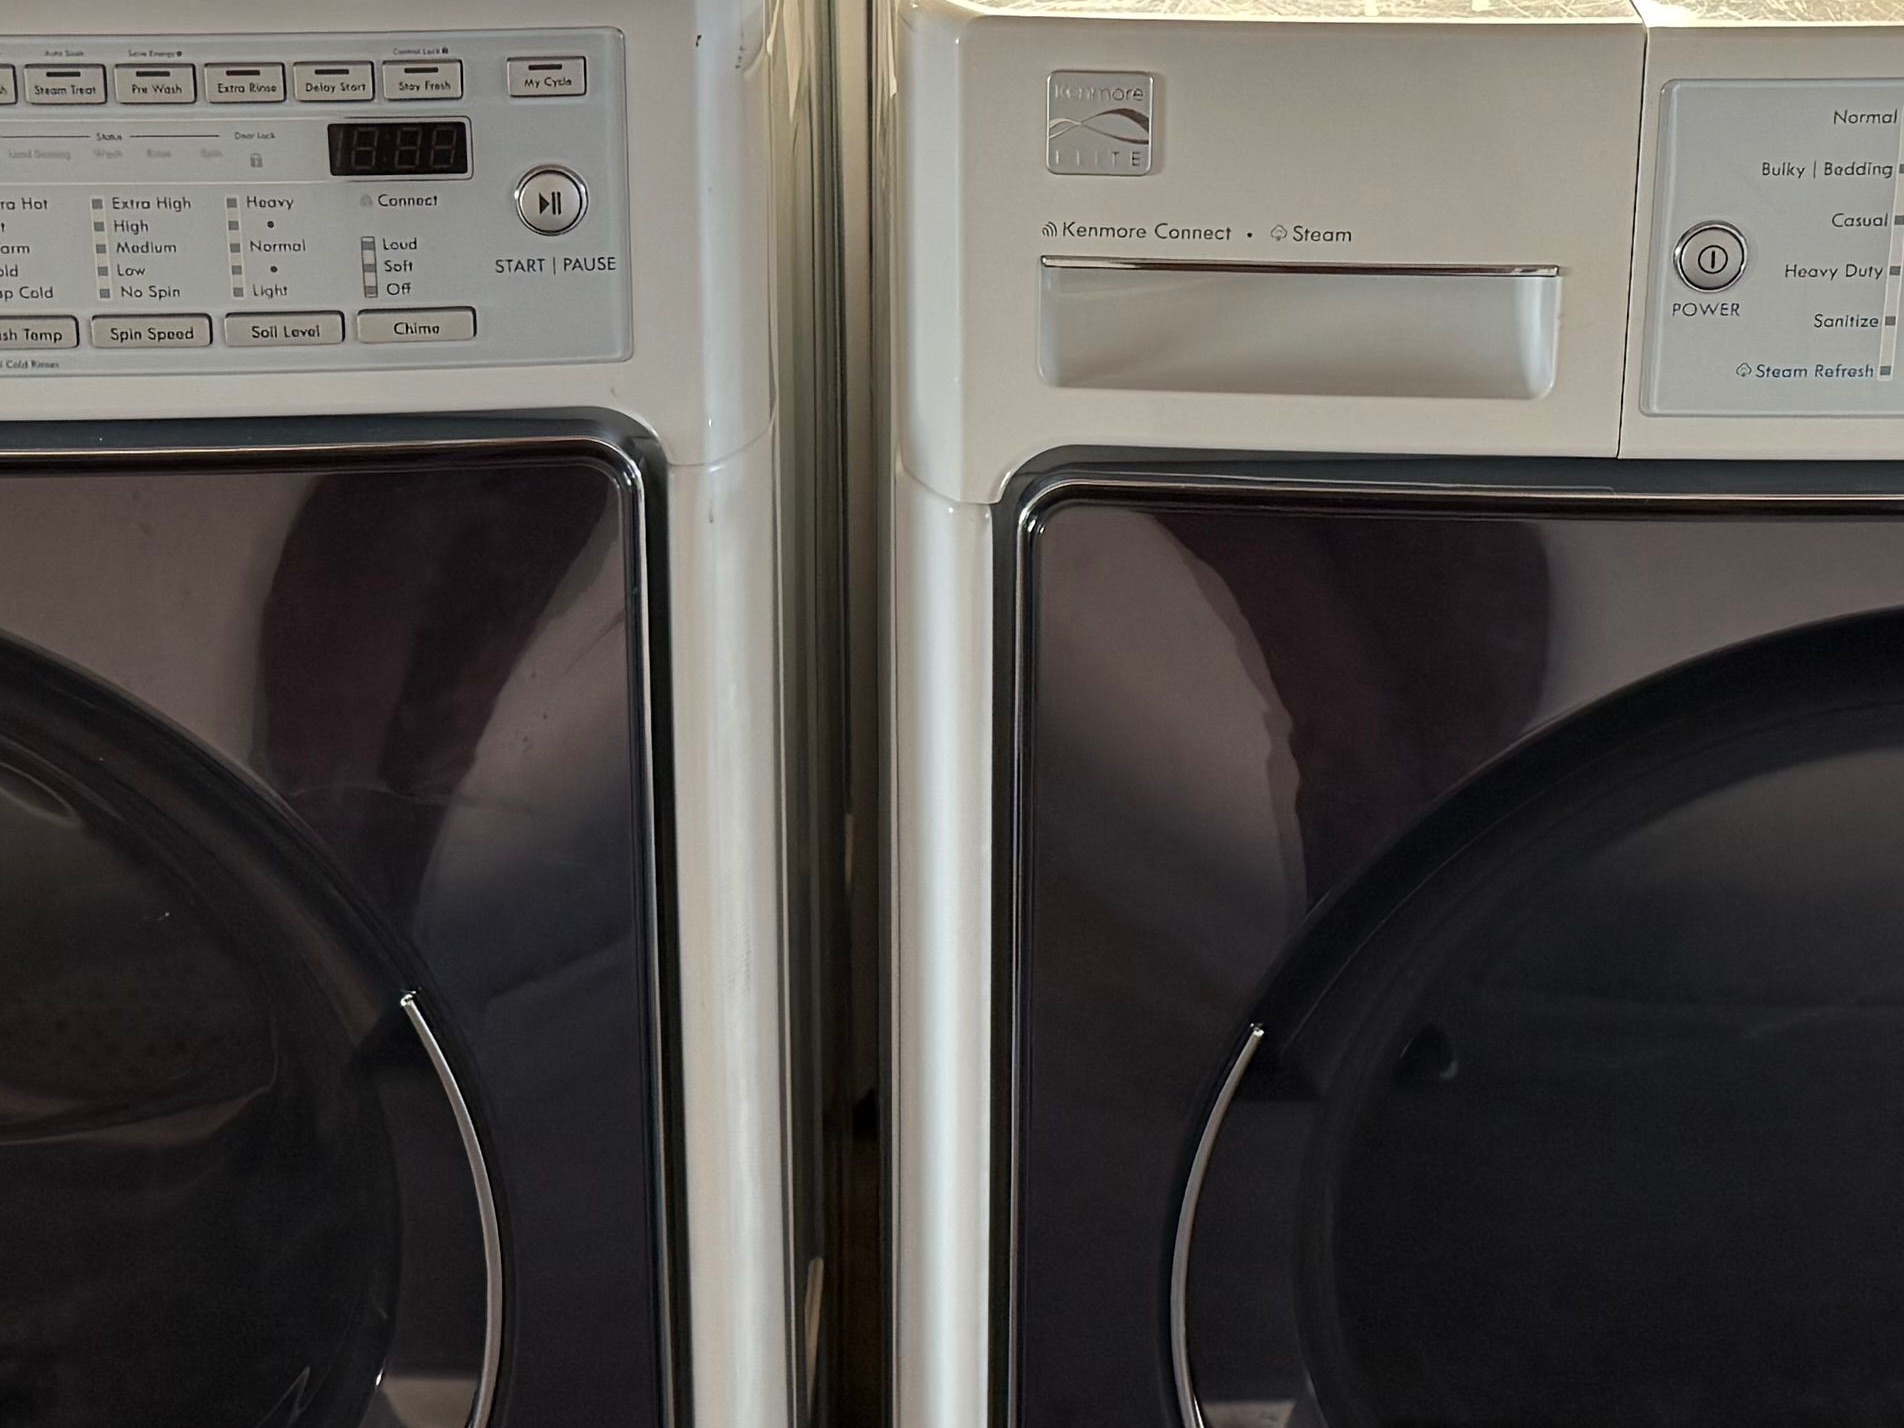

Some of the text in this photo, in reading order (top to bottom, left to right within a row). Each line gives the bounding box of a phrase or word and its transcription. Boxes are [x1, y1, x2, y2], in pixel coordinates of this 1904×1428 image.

[218, 83, 277, 93] Extra Rinse
[305, 82, 366, 94] Delay Start
[425, 81, 451, 91] Fresh
[525, 77, 572, 88] My Cycle
[34, 85, 96, 96] Steam Treat
[132, 85, 182, 94] Pre Wash
[1833, 109, 1897, 124] Normal
[1762, 162, 1893, 178] Bulky Bedding
[21, 198, 48, 210] Hot
[113, 197, 191, 212] Extra High
[247, 196, 294, 210] Heavy
[378, 194, 437, 207] Connect
[1832, 213, 1888, 227] Casual
[114, 220, 148, 235] High
[1062, 221, 1352, 244] Kenmore Connect Steam
[116, 242, 177, 254] Medium
[250, 239, 306, 252] Normal
[383, 238, 417, 250] Loud
[117, 264, 146, 276] Low
[384, 260, 413, 272] Soft
[496, 257, 616, 273] START PAUSE
[1785, 264, 1883, 281] Heavy Duty
[19, 287, 53, 299] Cold
[121, 286, 180, 300] No Spin
[253, 285, 288, 299] Light
[387, 283, 411, 295] Off
[1672, 303, 1740, 317] POWER
[1814, 314, 1879, 328] Sanitize
[111, 327, 194, 343] Spin Speed
[252, 325, 320, 338] Soil Level
[394, 322, 439, 335] Chime
[24, 329, 62, 344] Temp
[1756, 364, 1874, 378] Steam Refresh
